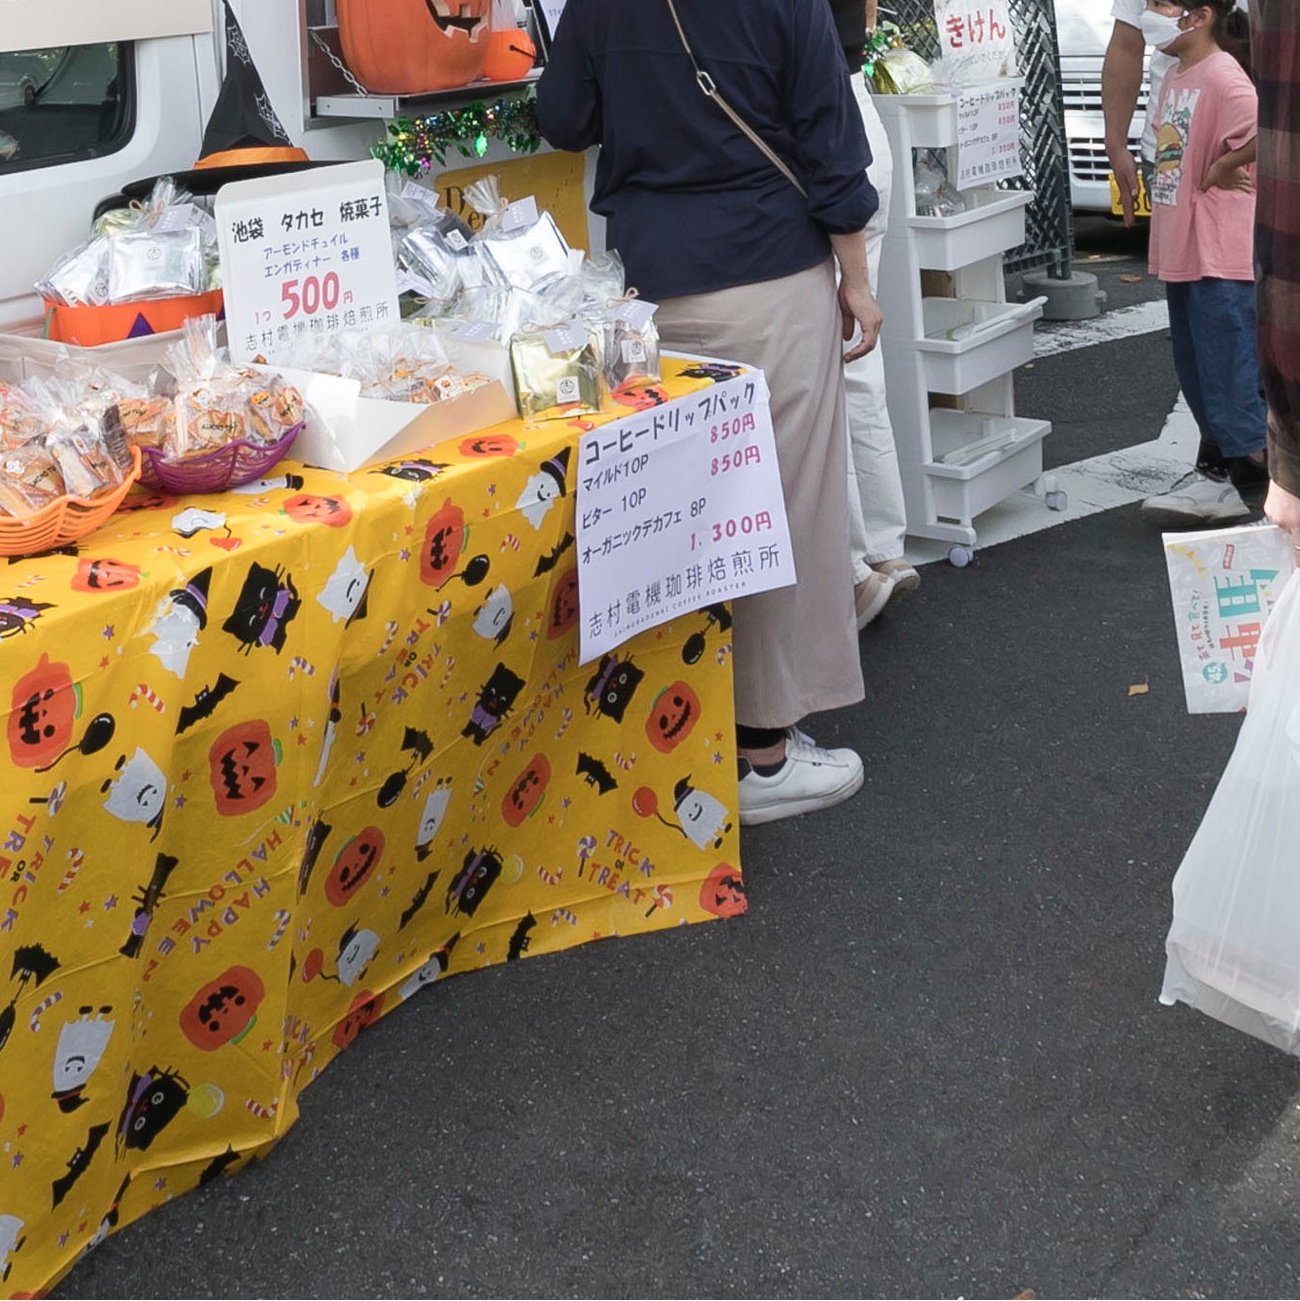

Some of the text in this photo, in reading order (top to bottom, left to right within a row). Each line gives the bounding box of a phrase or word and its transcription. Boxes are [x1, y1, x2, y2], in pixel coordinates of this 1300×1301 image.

[946, 9, 1006, 48] きけん
[231, 196, 383, 244] 池袋 タカセ 焼菓子
[263, 232, 348, 260] アーモンドチュイル
[340, 247, 361, 263] 各種
[582, 411, 756, 491] マイルド10P 850円
[585, 381, 756, 465] コーヒードリップパック
[582, 444, 762, 530] ビター 10P 850円
[582, 496, 707, 565] オーガニックデカフェ 8P
[588, 541, 782, 640] 志村電機珈琲焙煎所
[0, 833, 57, 932] TRICK
[586, 862, 646, 906] TREAT
[603, 829, 655, 879] TRICK
[190, 876, 272, 954] HAPPY
